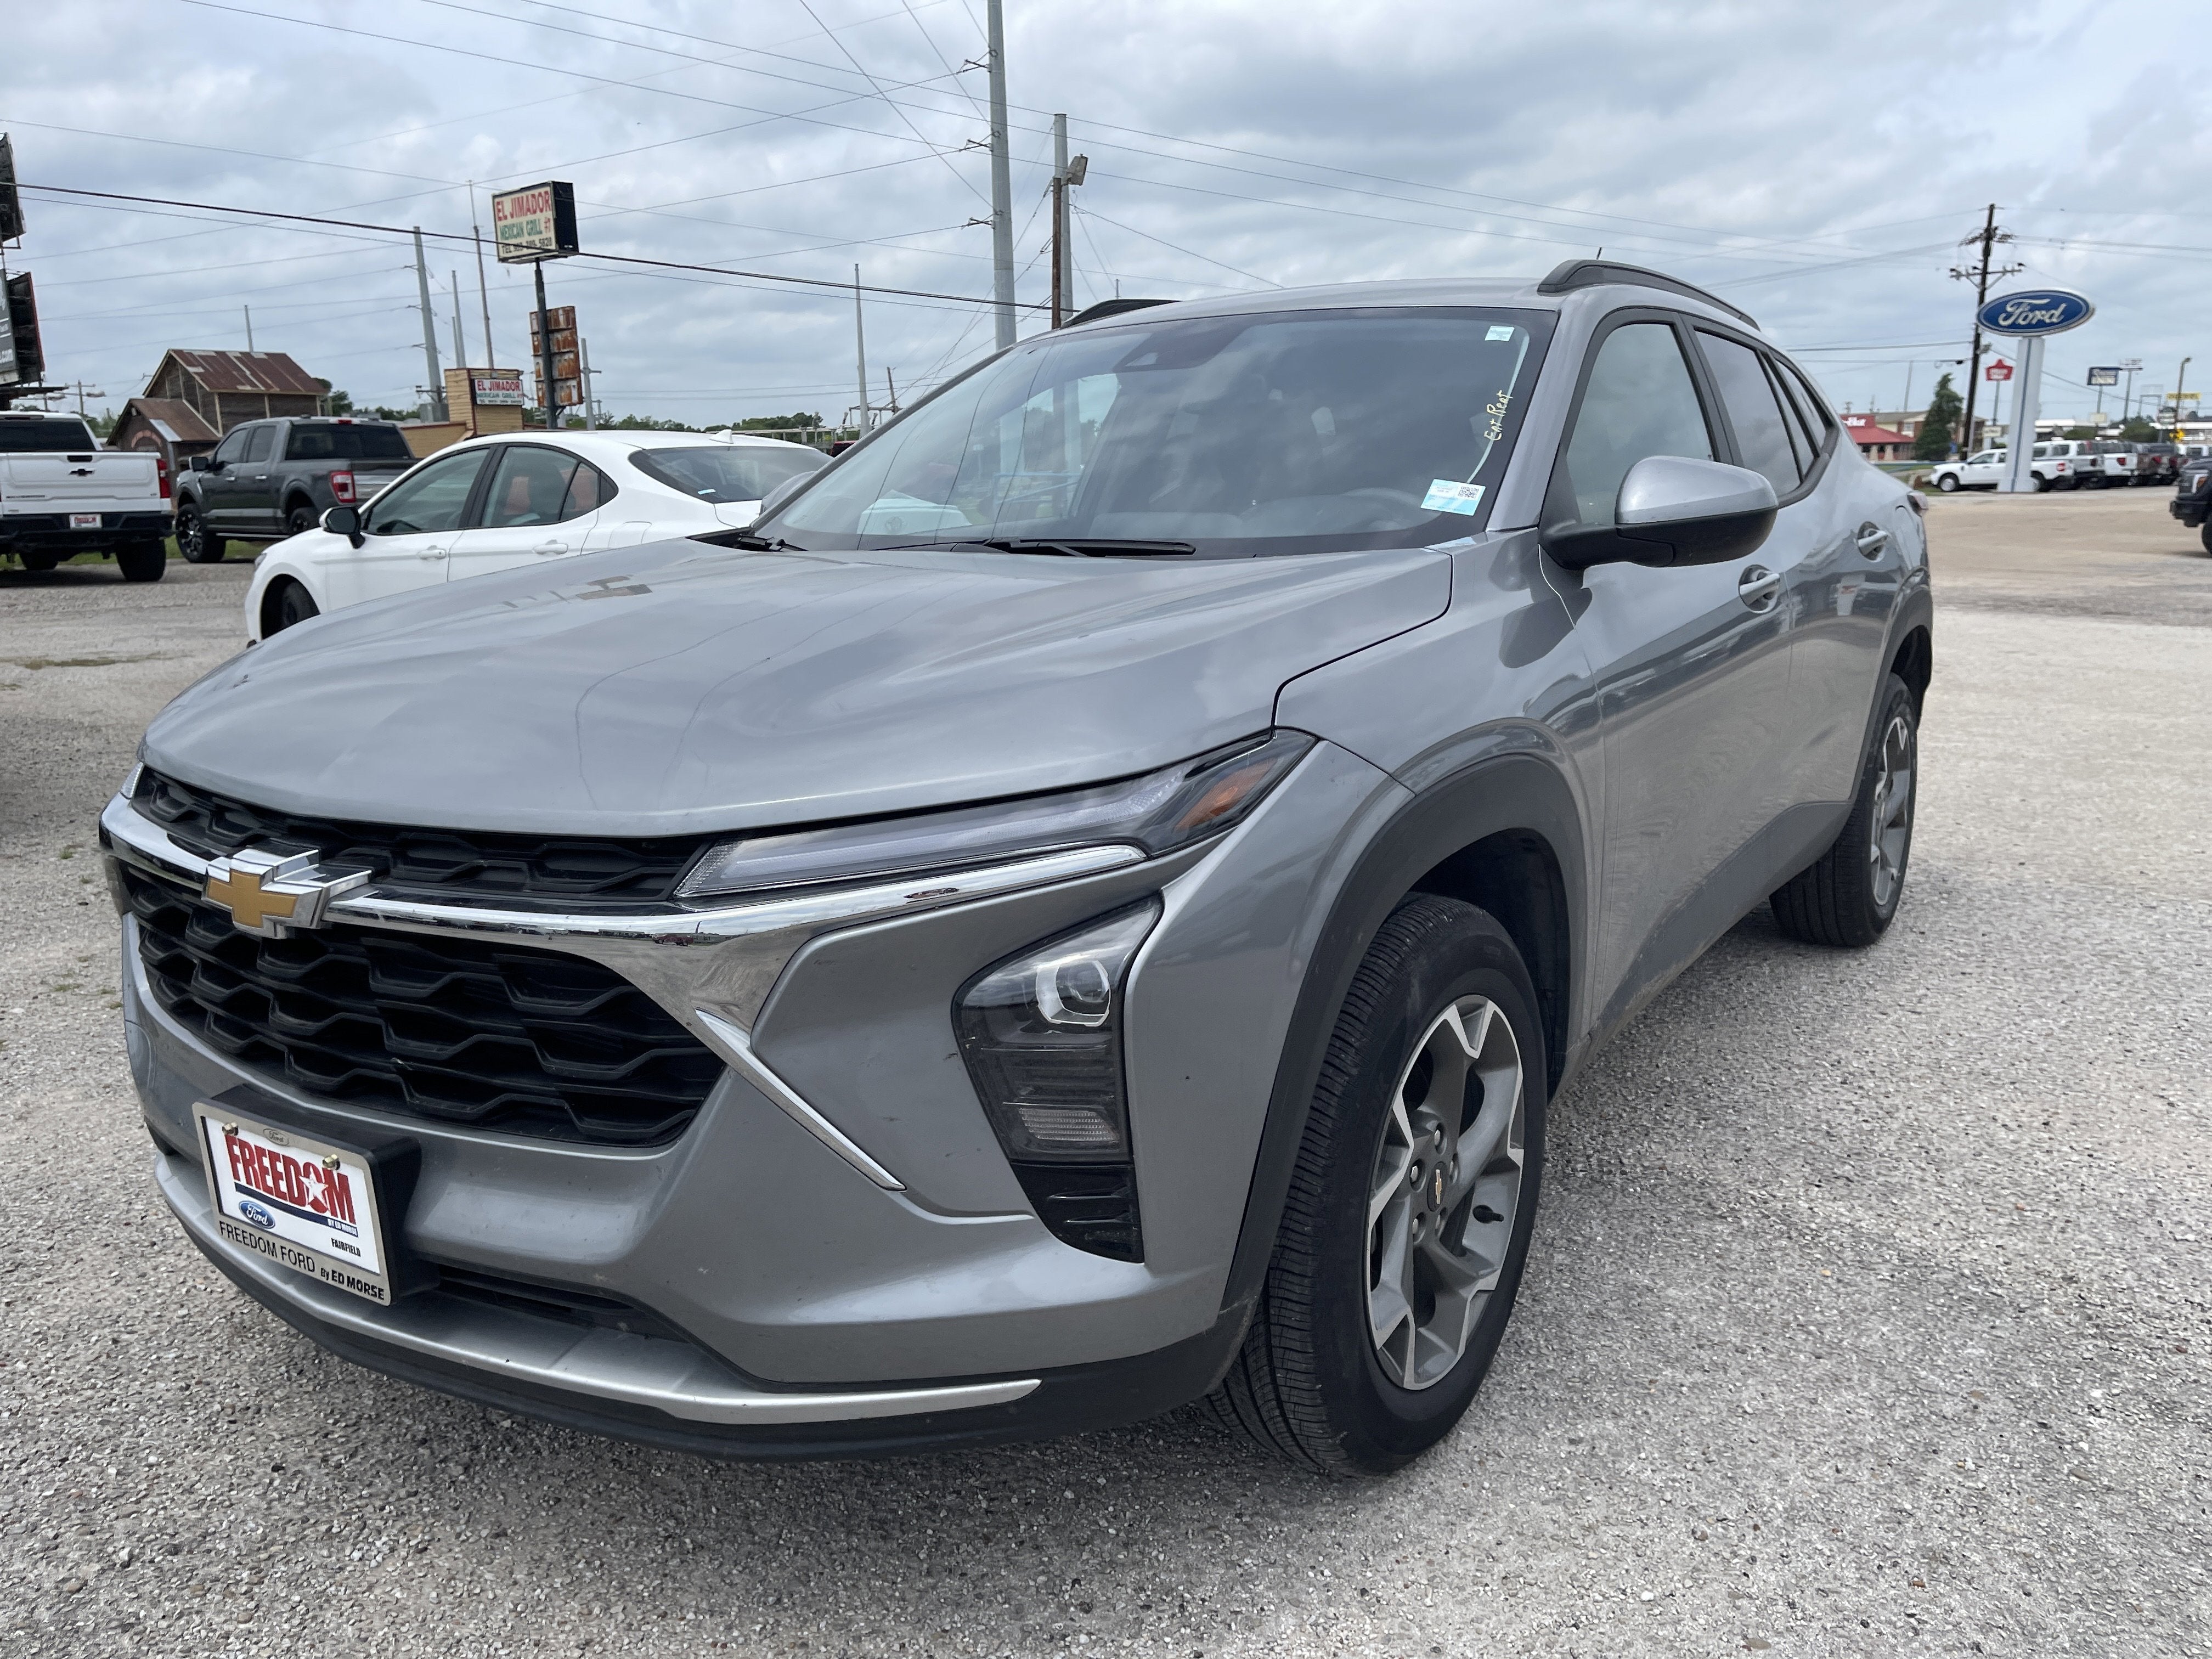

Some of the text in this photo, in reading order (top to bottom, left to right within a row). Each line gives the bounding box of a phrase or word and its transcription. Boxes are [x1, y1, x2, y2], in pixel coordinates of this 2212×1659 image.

[495, 191, 552, 221] EL JIMADOR
[500, 222, 524, 241] MEXICAN
[526, 218, 543, 236] GRILL
[1998, 298, 2067, 326] Ford
[477, 380, 521, 391] EL JIMADOR
[225, 1134, 357, 1225] FREEDOM
[246, 1204, 268, 1226] Ford
[331, 1238, 361, 1257] FAIRFIELD
[219, 1221, 385, 1300] FREEDOM FORD By ED MORSE
